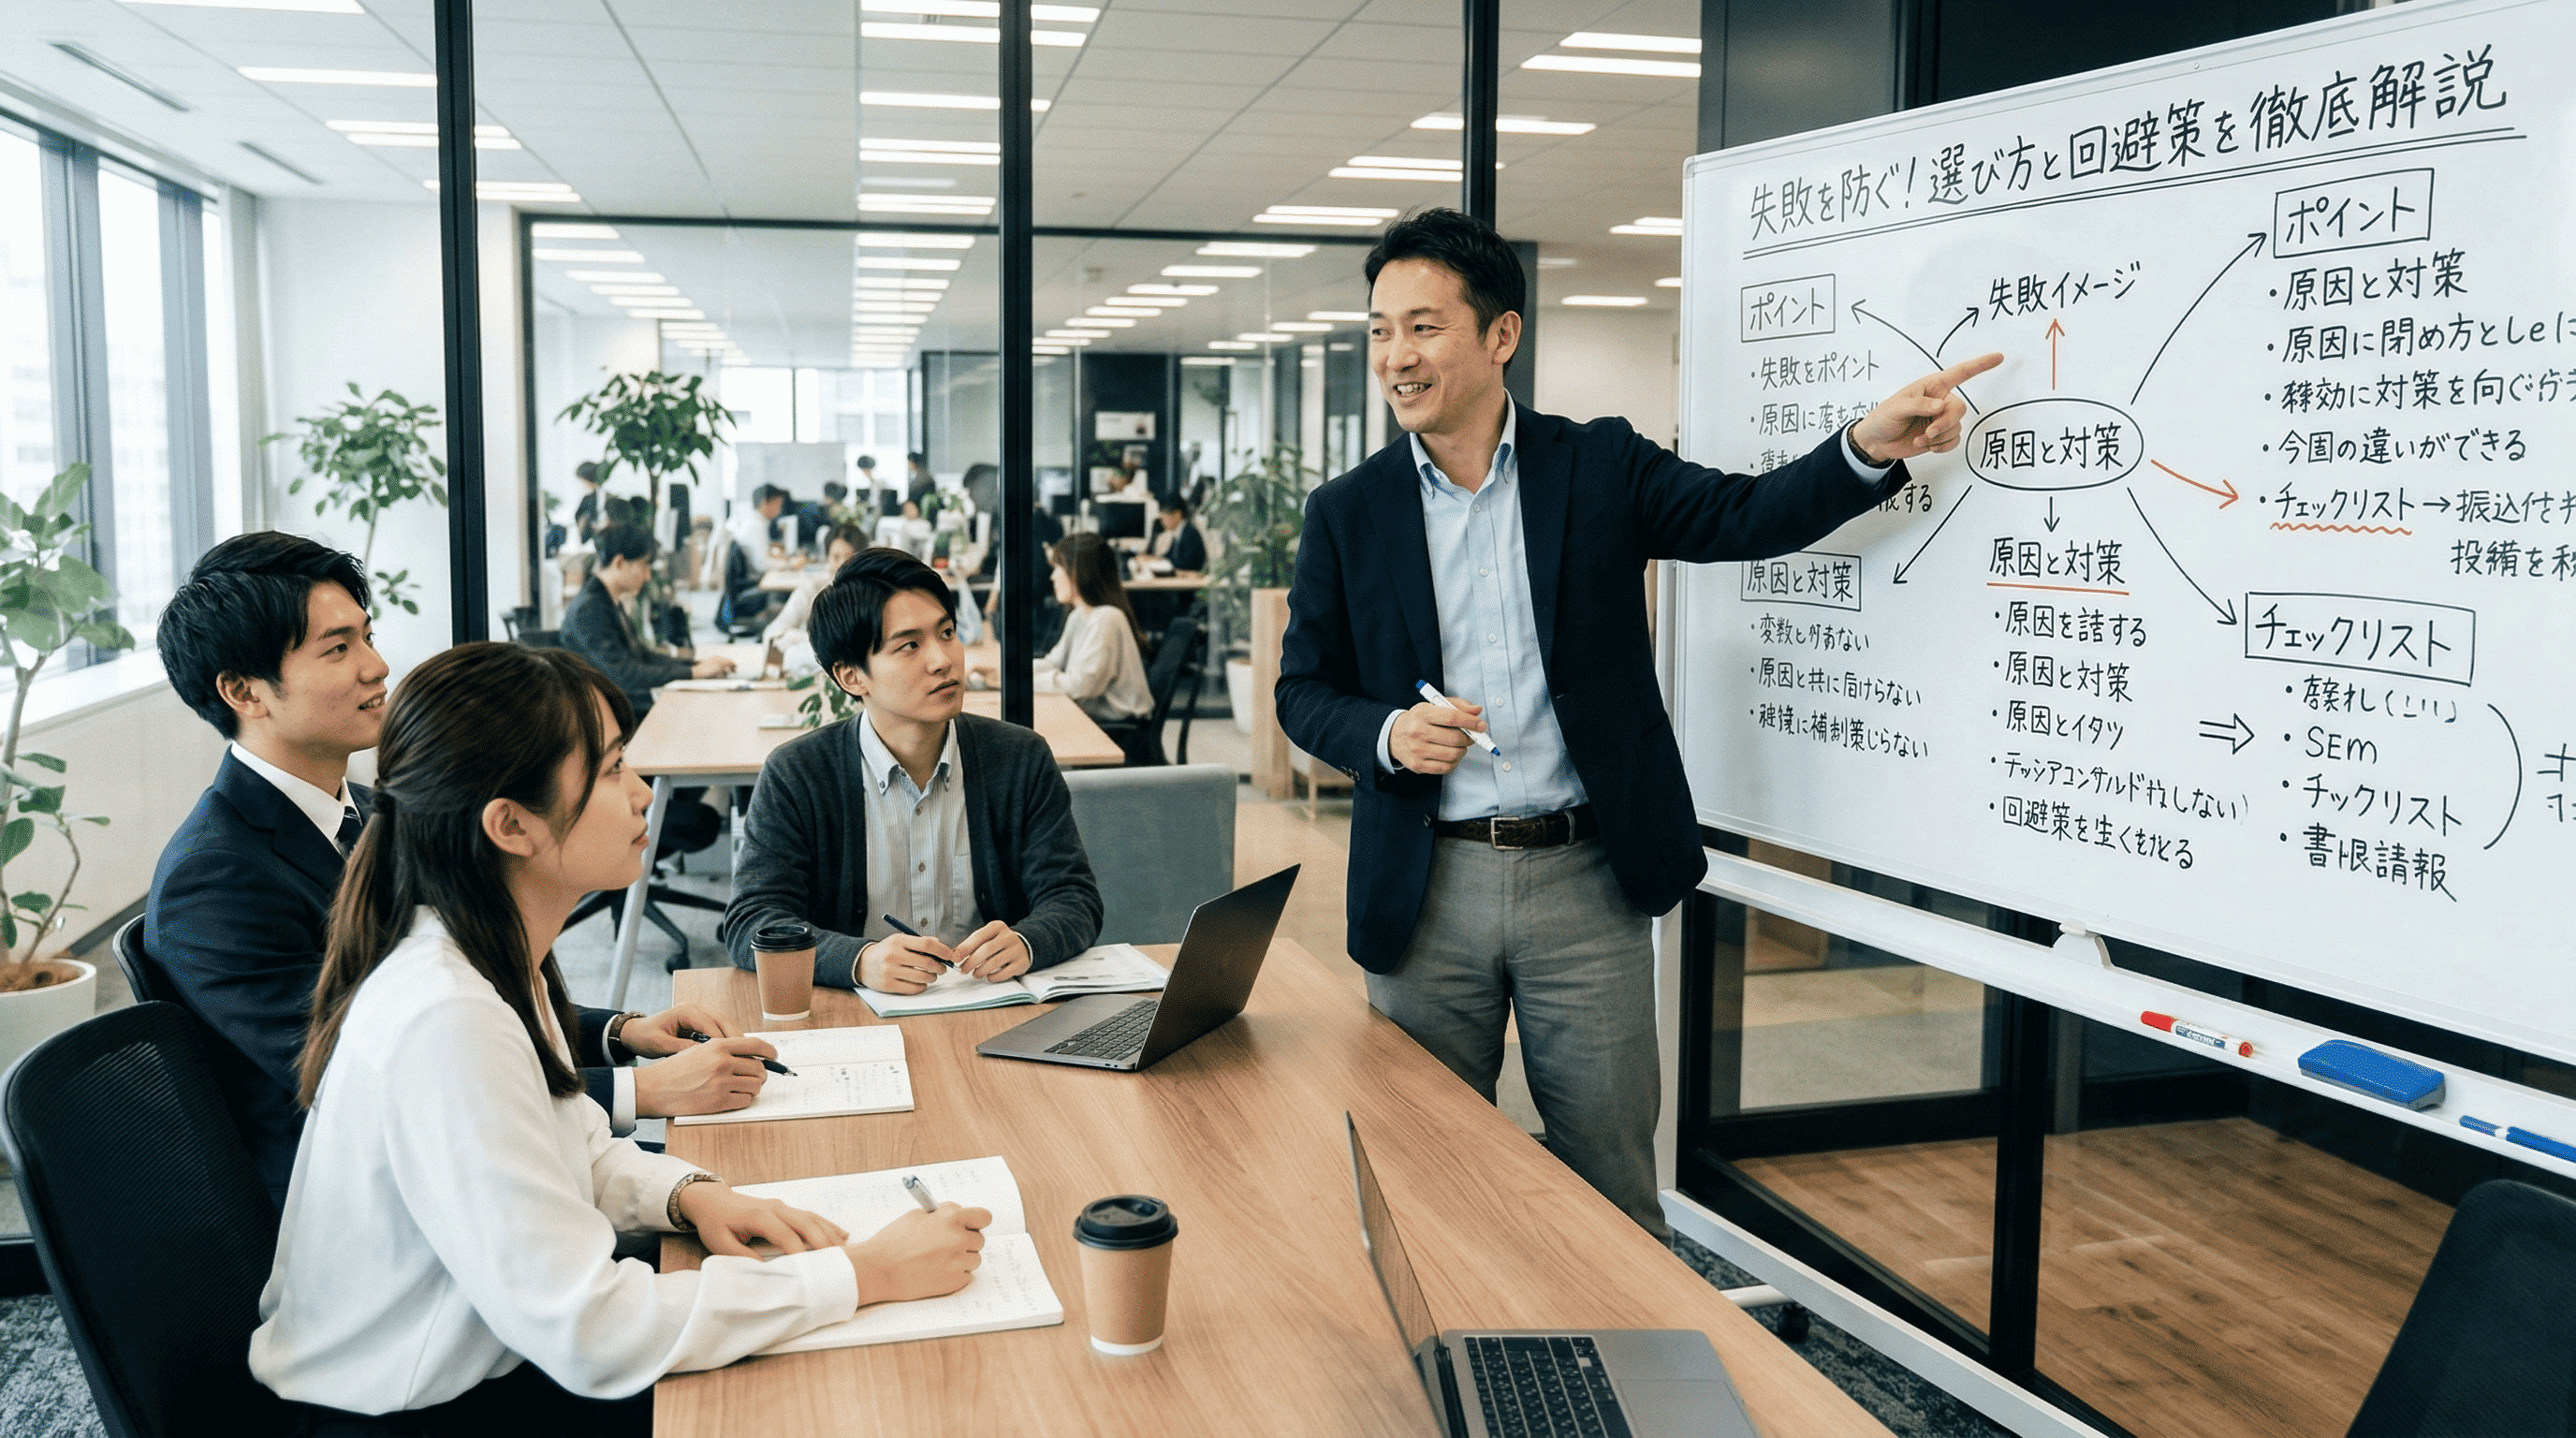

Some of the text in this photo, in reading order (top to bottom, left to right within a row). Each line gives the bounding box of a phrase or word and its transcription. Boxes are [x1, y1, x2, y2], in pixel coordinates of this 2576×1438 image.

[2286, 186, 2415, 243] ポイント
[1989, 260, 2141, 320] 失敗イメージ
[2284, 248, 2468, 311] 原因と対策
[1750, 286, 1824, 330] ポイント
[1761, 349, 1880, 390] 失敗をポイント
[1980, 421, 2123, 470] 原因と対策
[2275, 481, 2415, 521] チェックリスト
[1748, 560, 1853, 602] 原因と対策
[1989, 536, 2125, 585] 原因と対策
[2255, 604, 2451, 667] チェックリスト
[2005, 651, 2132, 702] 原因と対策
[2303, 773, 2462, 836] チックリスト
